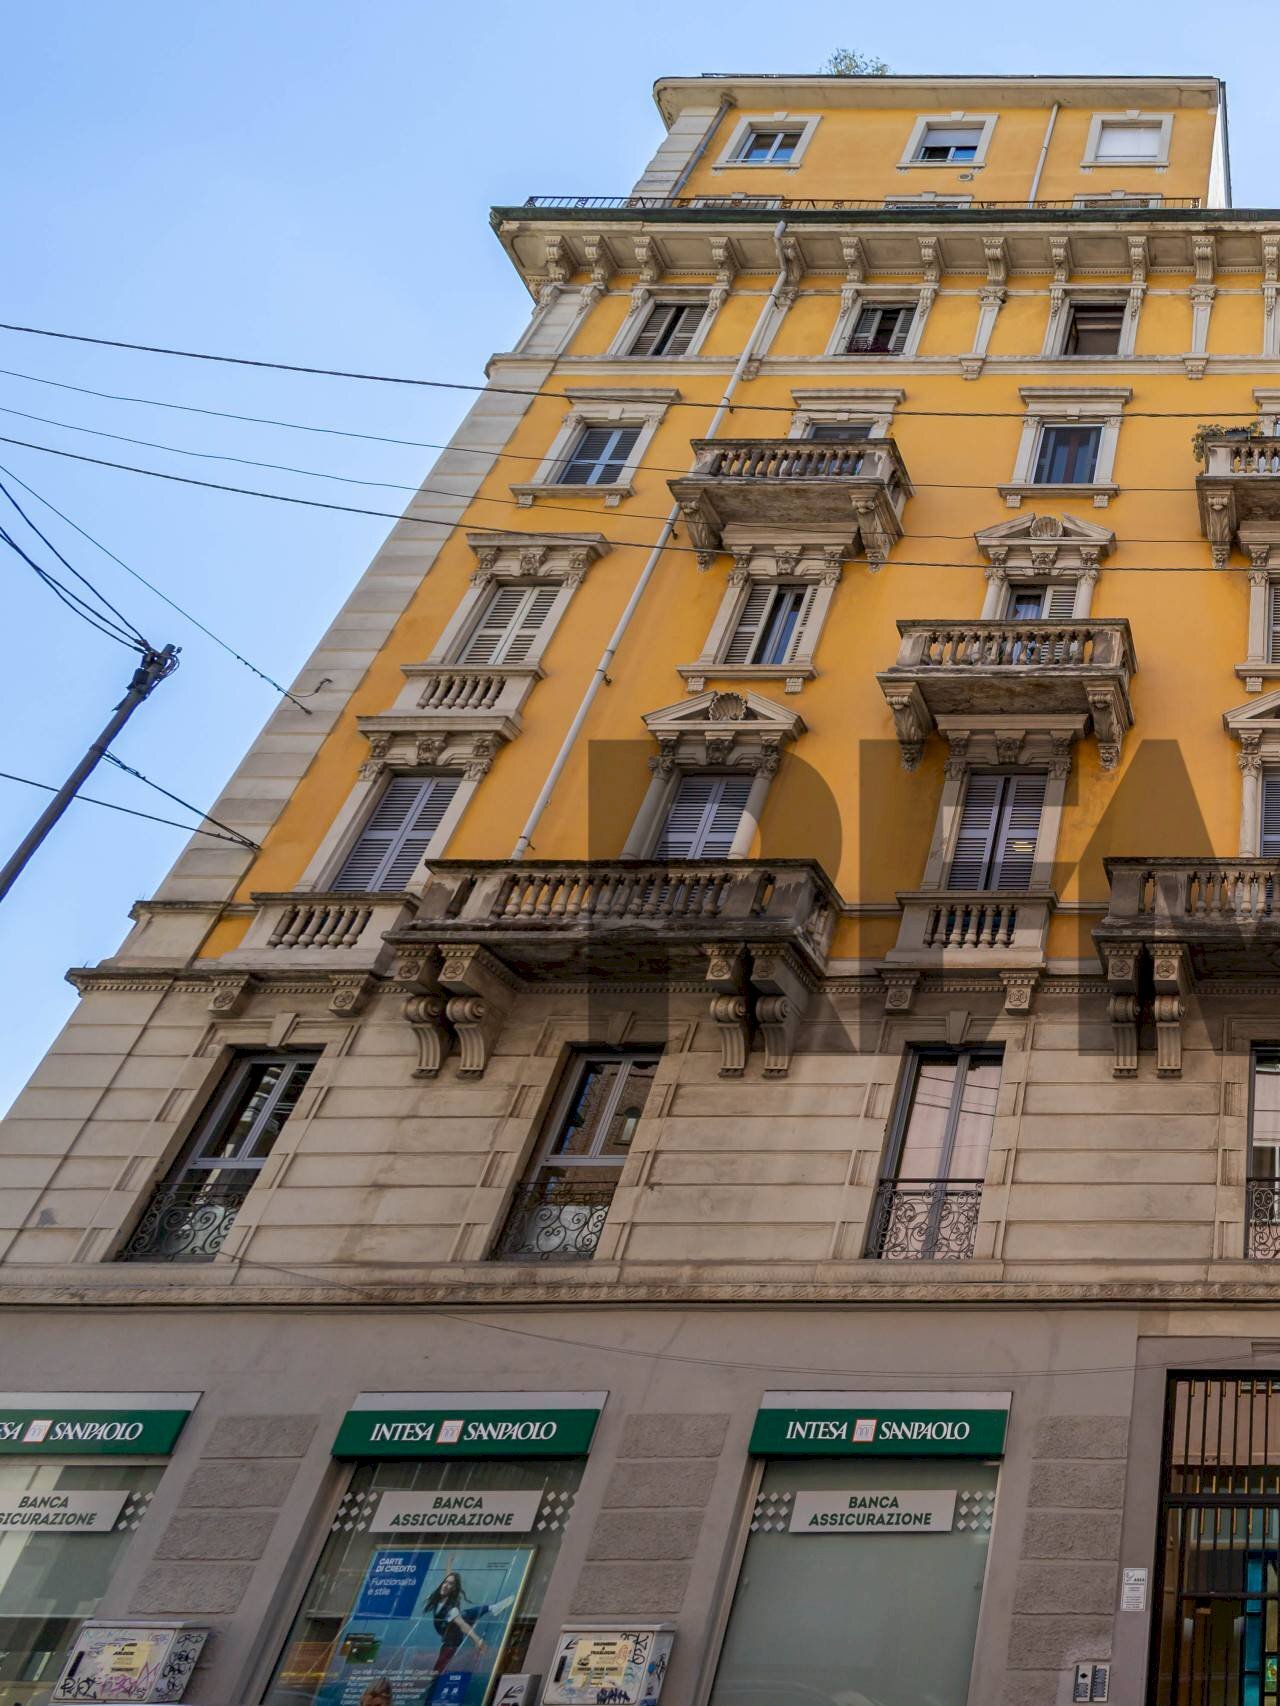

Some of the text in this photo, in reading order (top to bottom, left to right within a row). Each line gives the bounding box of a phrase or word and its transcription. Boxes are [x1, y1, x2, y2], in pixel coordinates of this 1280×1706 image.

[50, 1422, 144, 1441] SANPAOLO
[369, 1421, 557, 1441] INTESA SANPAOLO
[785, 1421, 970, 1440] INTESA SANPAOLO
[18, 1496, 69, 1509] BANCA
[432, 1496, 483, 1509] BANCA
[848, 1496, 900, 1509] BANCA
[0, 1512, 98, 1526] SICURAZIONE
[390, 1512, 514, 1526] ASSICURAZIONE
[808, 1512, 932, 1526] ASSICURAZIONE
[375, 1565, 417, 1573] DI CREDITO
[374, 1588, 391, 1596] stile
